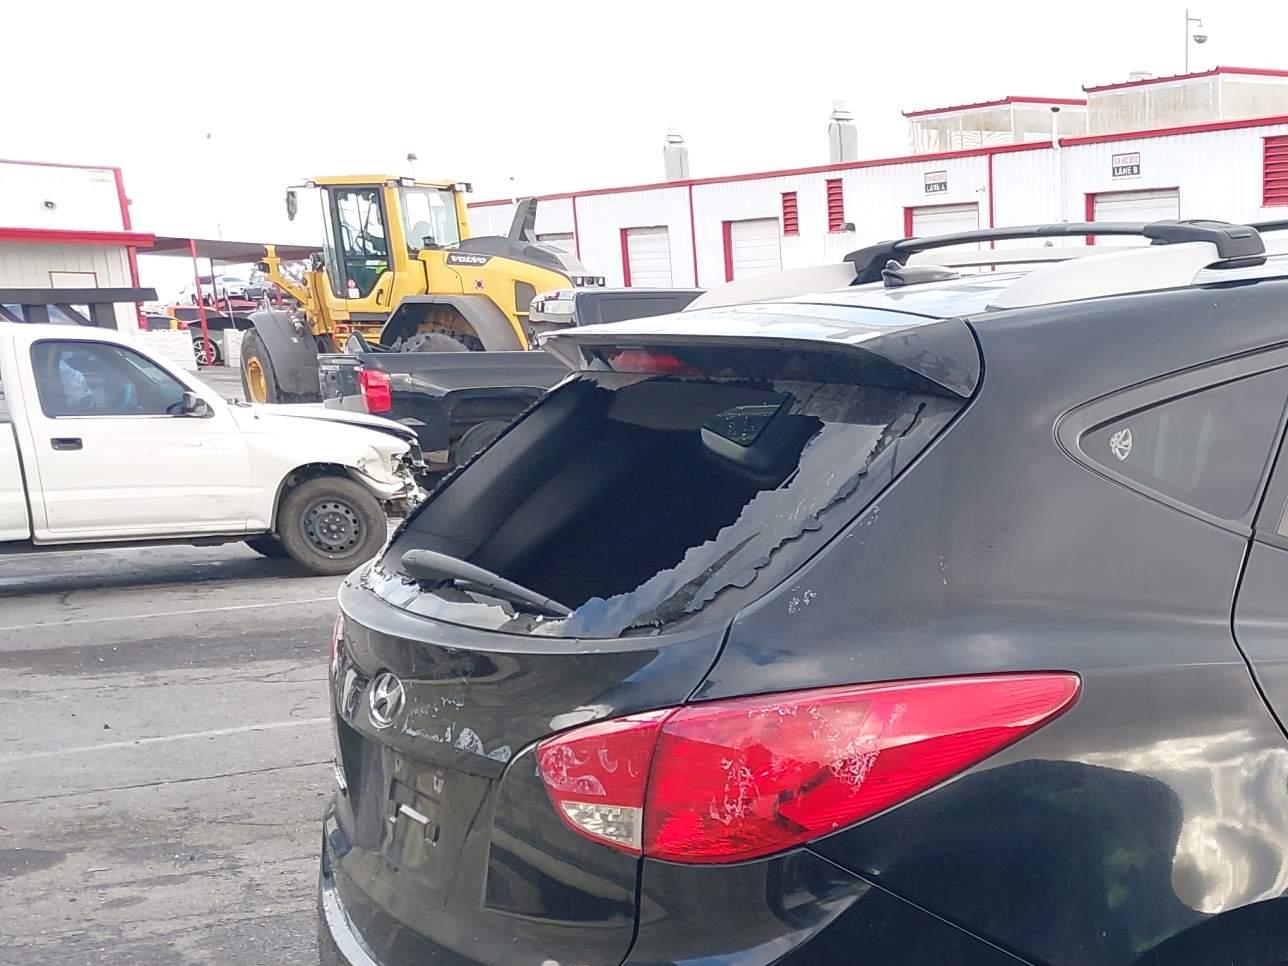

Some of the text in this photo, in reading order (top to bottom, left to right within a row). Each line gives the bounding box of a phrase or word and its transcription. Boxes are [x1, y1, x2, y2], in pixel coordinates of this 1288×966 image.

[1114, 166, 1138, 175] LANE B
[451, 255, 487, 264] VOLVO
